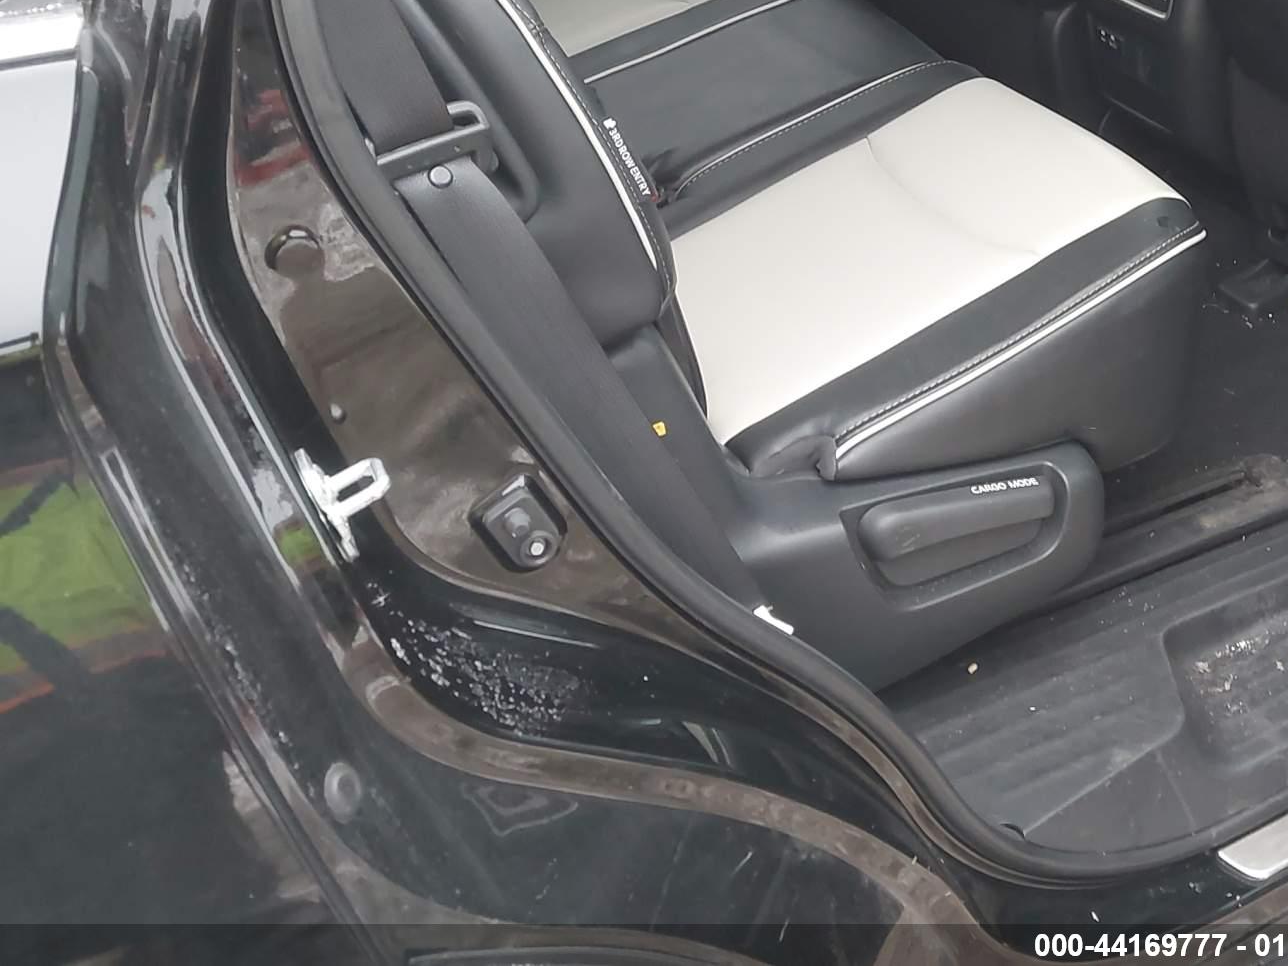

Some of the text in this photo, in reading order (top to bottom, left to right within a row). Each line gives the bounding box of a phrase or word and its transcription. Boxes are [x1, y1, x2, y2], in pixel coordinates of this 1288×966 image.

[608, 127, 651, 196] 3RD ROW ENTRY
[970, 477, 1040, 494] CARGO MODE
